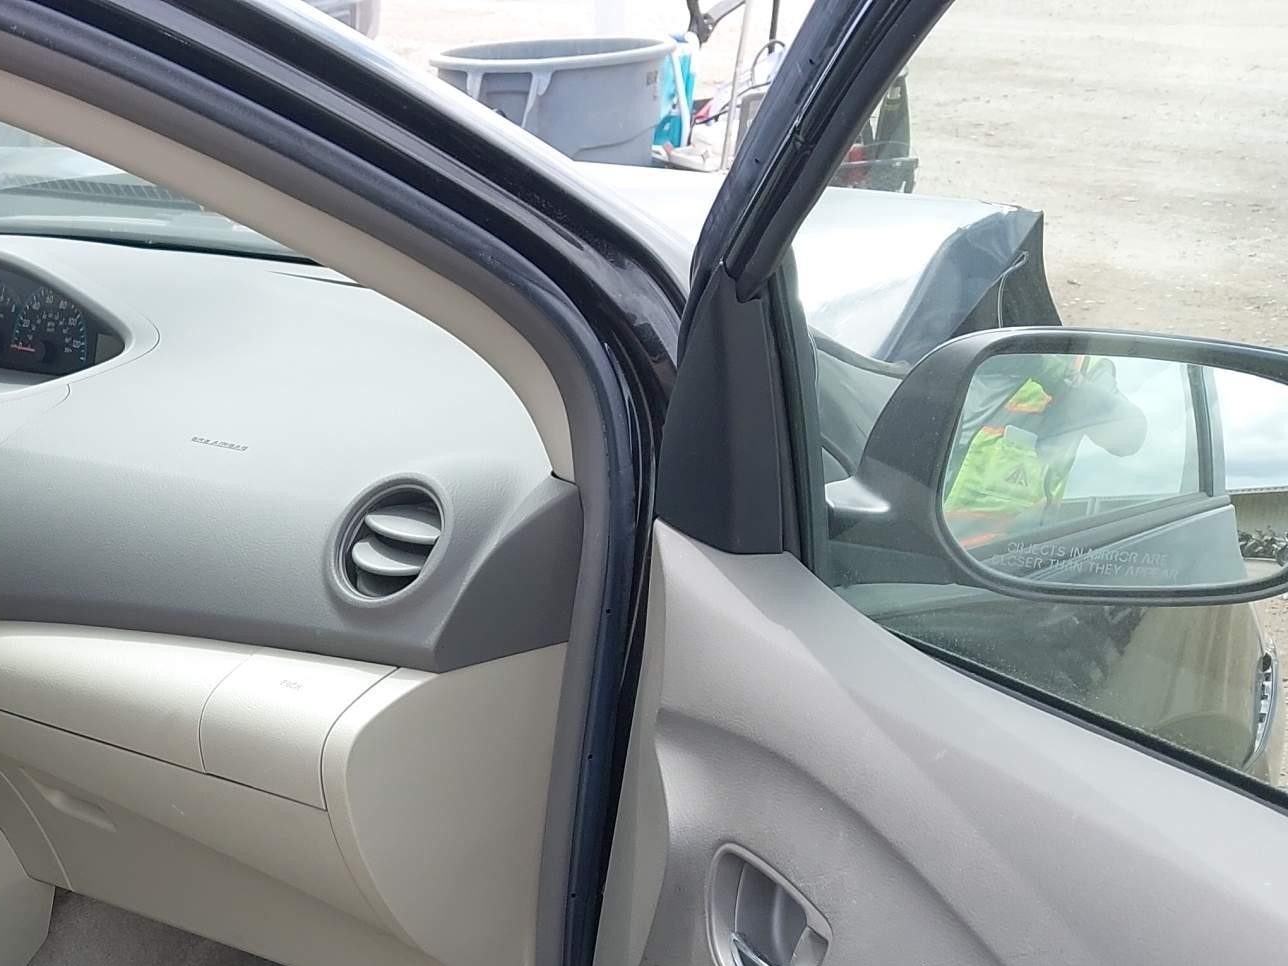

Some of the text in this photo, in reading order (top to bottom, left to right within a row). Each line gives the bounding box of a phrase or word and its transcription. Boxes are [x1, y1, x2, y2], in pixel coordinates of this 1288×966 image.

[1007, 542, 1168, 565] OBJECTS IN MIRROR ARE
[1048, 558, 1083, 573] THAN
[1088, 561, 1122, 576] THEY
[1124, 564, 1180, 580] APPEAR
